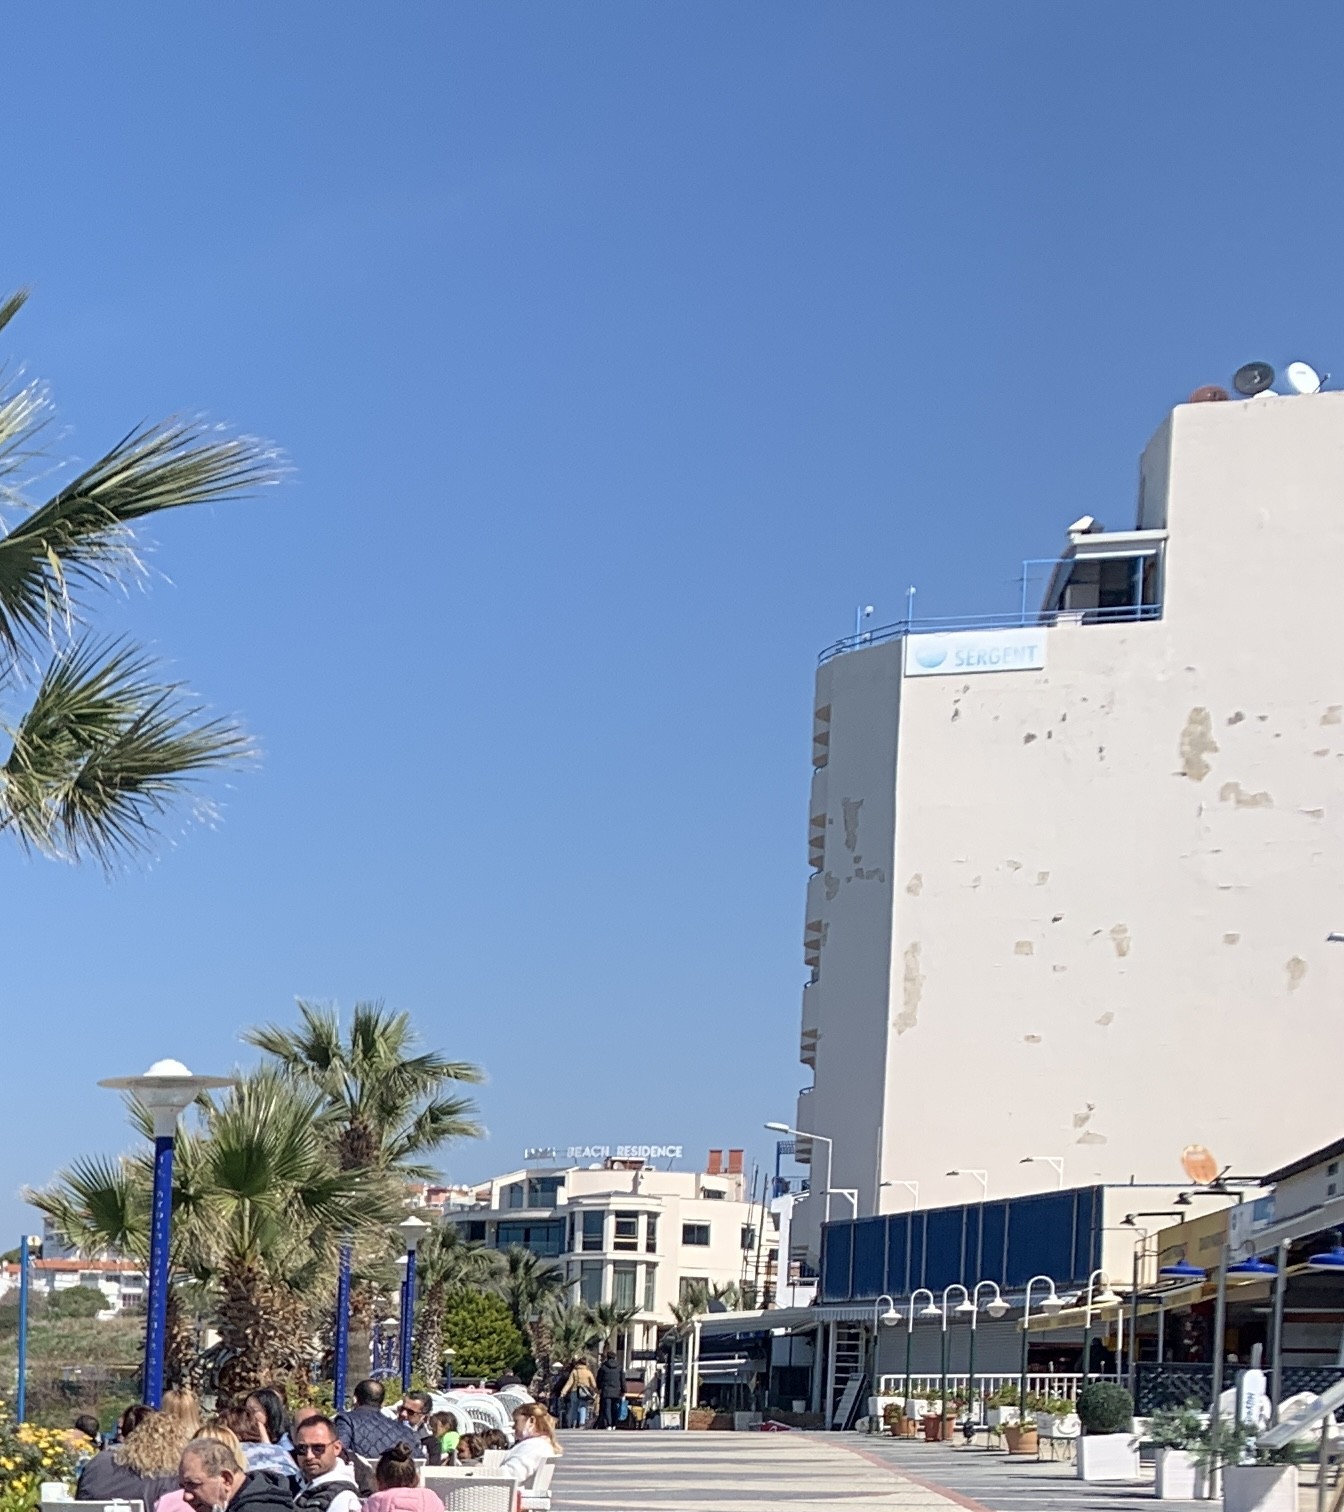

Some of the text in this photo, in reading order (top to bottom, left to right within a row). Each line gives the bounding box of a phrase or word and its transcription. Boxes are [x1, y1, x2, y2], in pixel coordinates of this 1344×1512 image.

[955, 645, 1038, 667] SERGENT
[567, 1145, 610, 1159] BEACH
[616, 1145, 683, 1159] RESIDENCE
